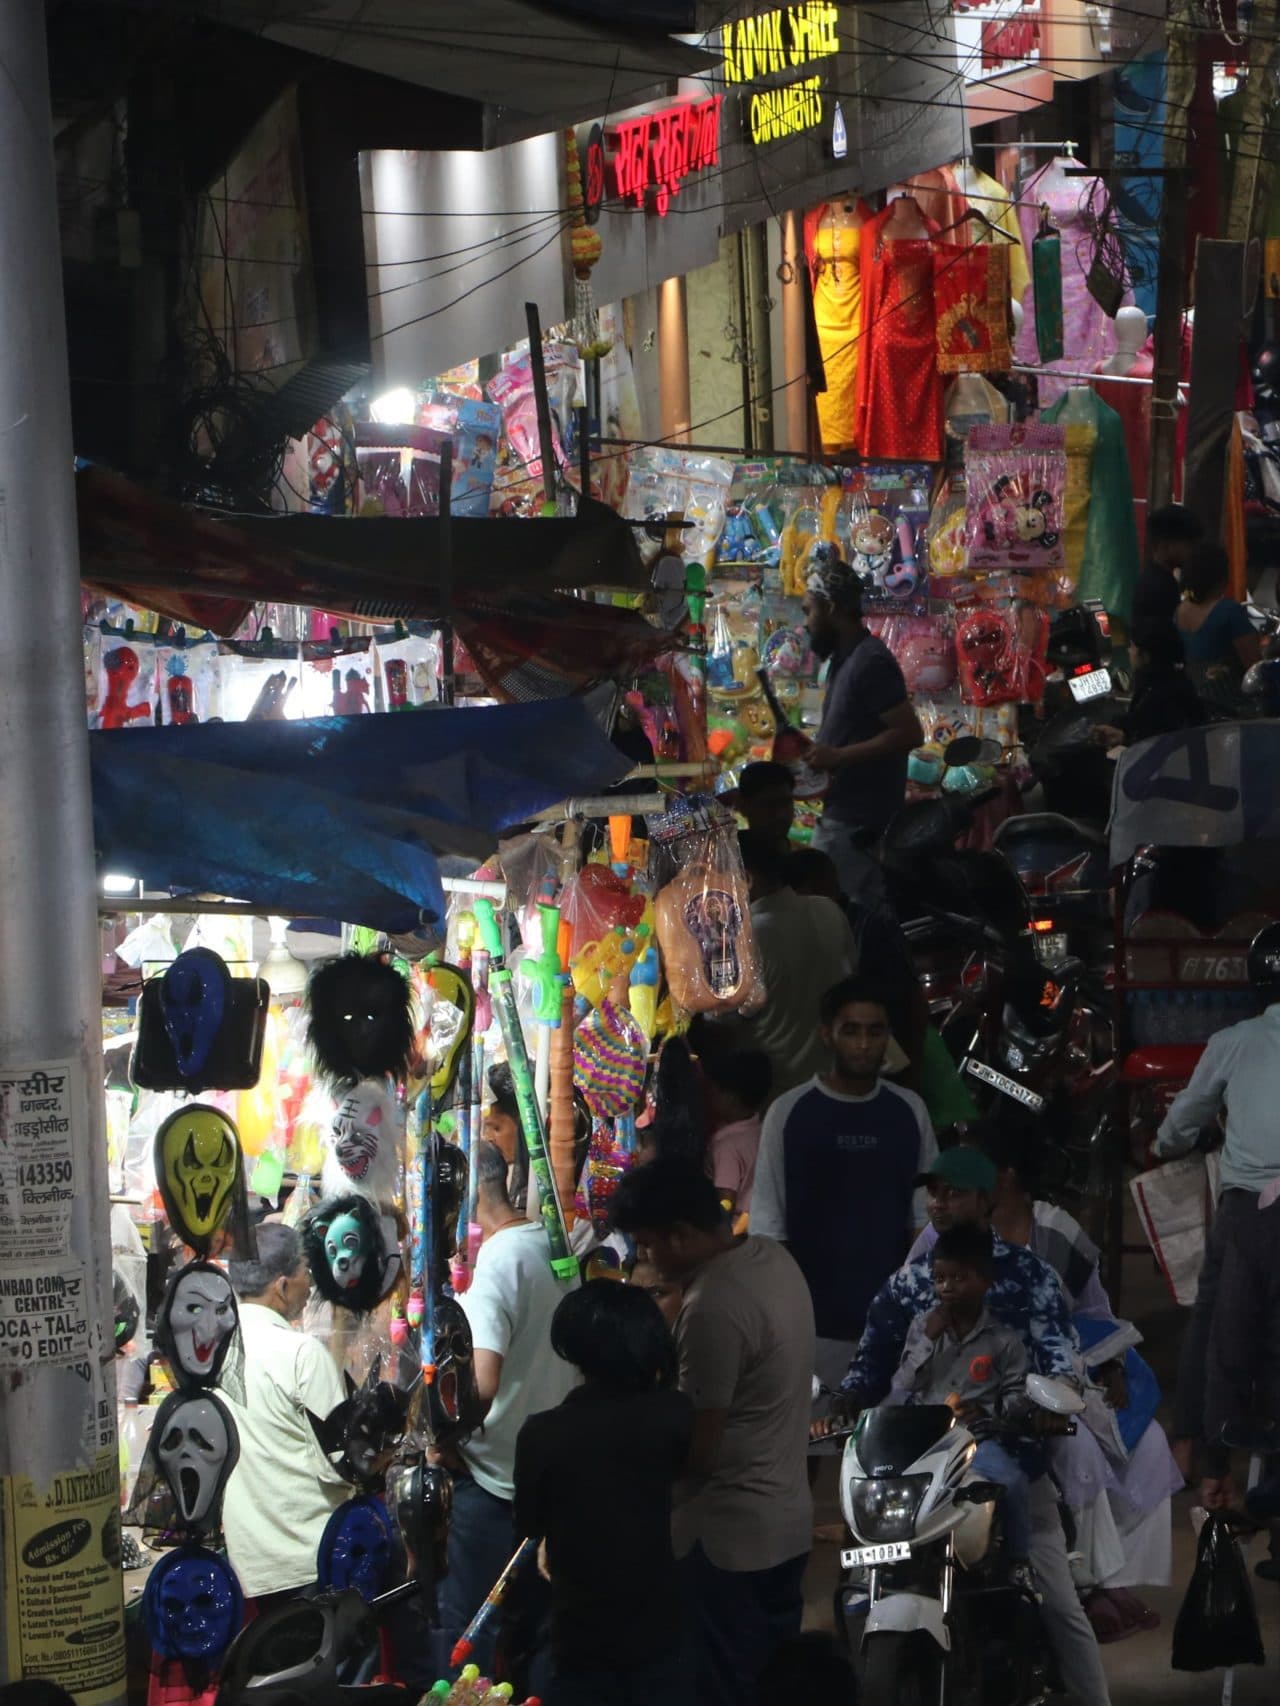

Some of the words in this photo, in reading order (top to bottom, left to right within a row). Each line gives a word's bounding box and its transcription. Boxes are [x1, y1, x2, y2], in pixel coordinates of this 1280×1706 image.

[721, 8, 786, 88] KANAK
[786, 0, 840, 67] SHREE
[750, 74, 822, 145] ORNAMENTS
[27, 1528, 72, 1561] Admission
